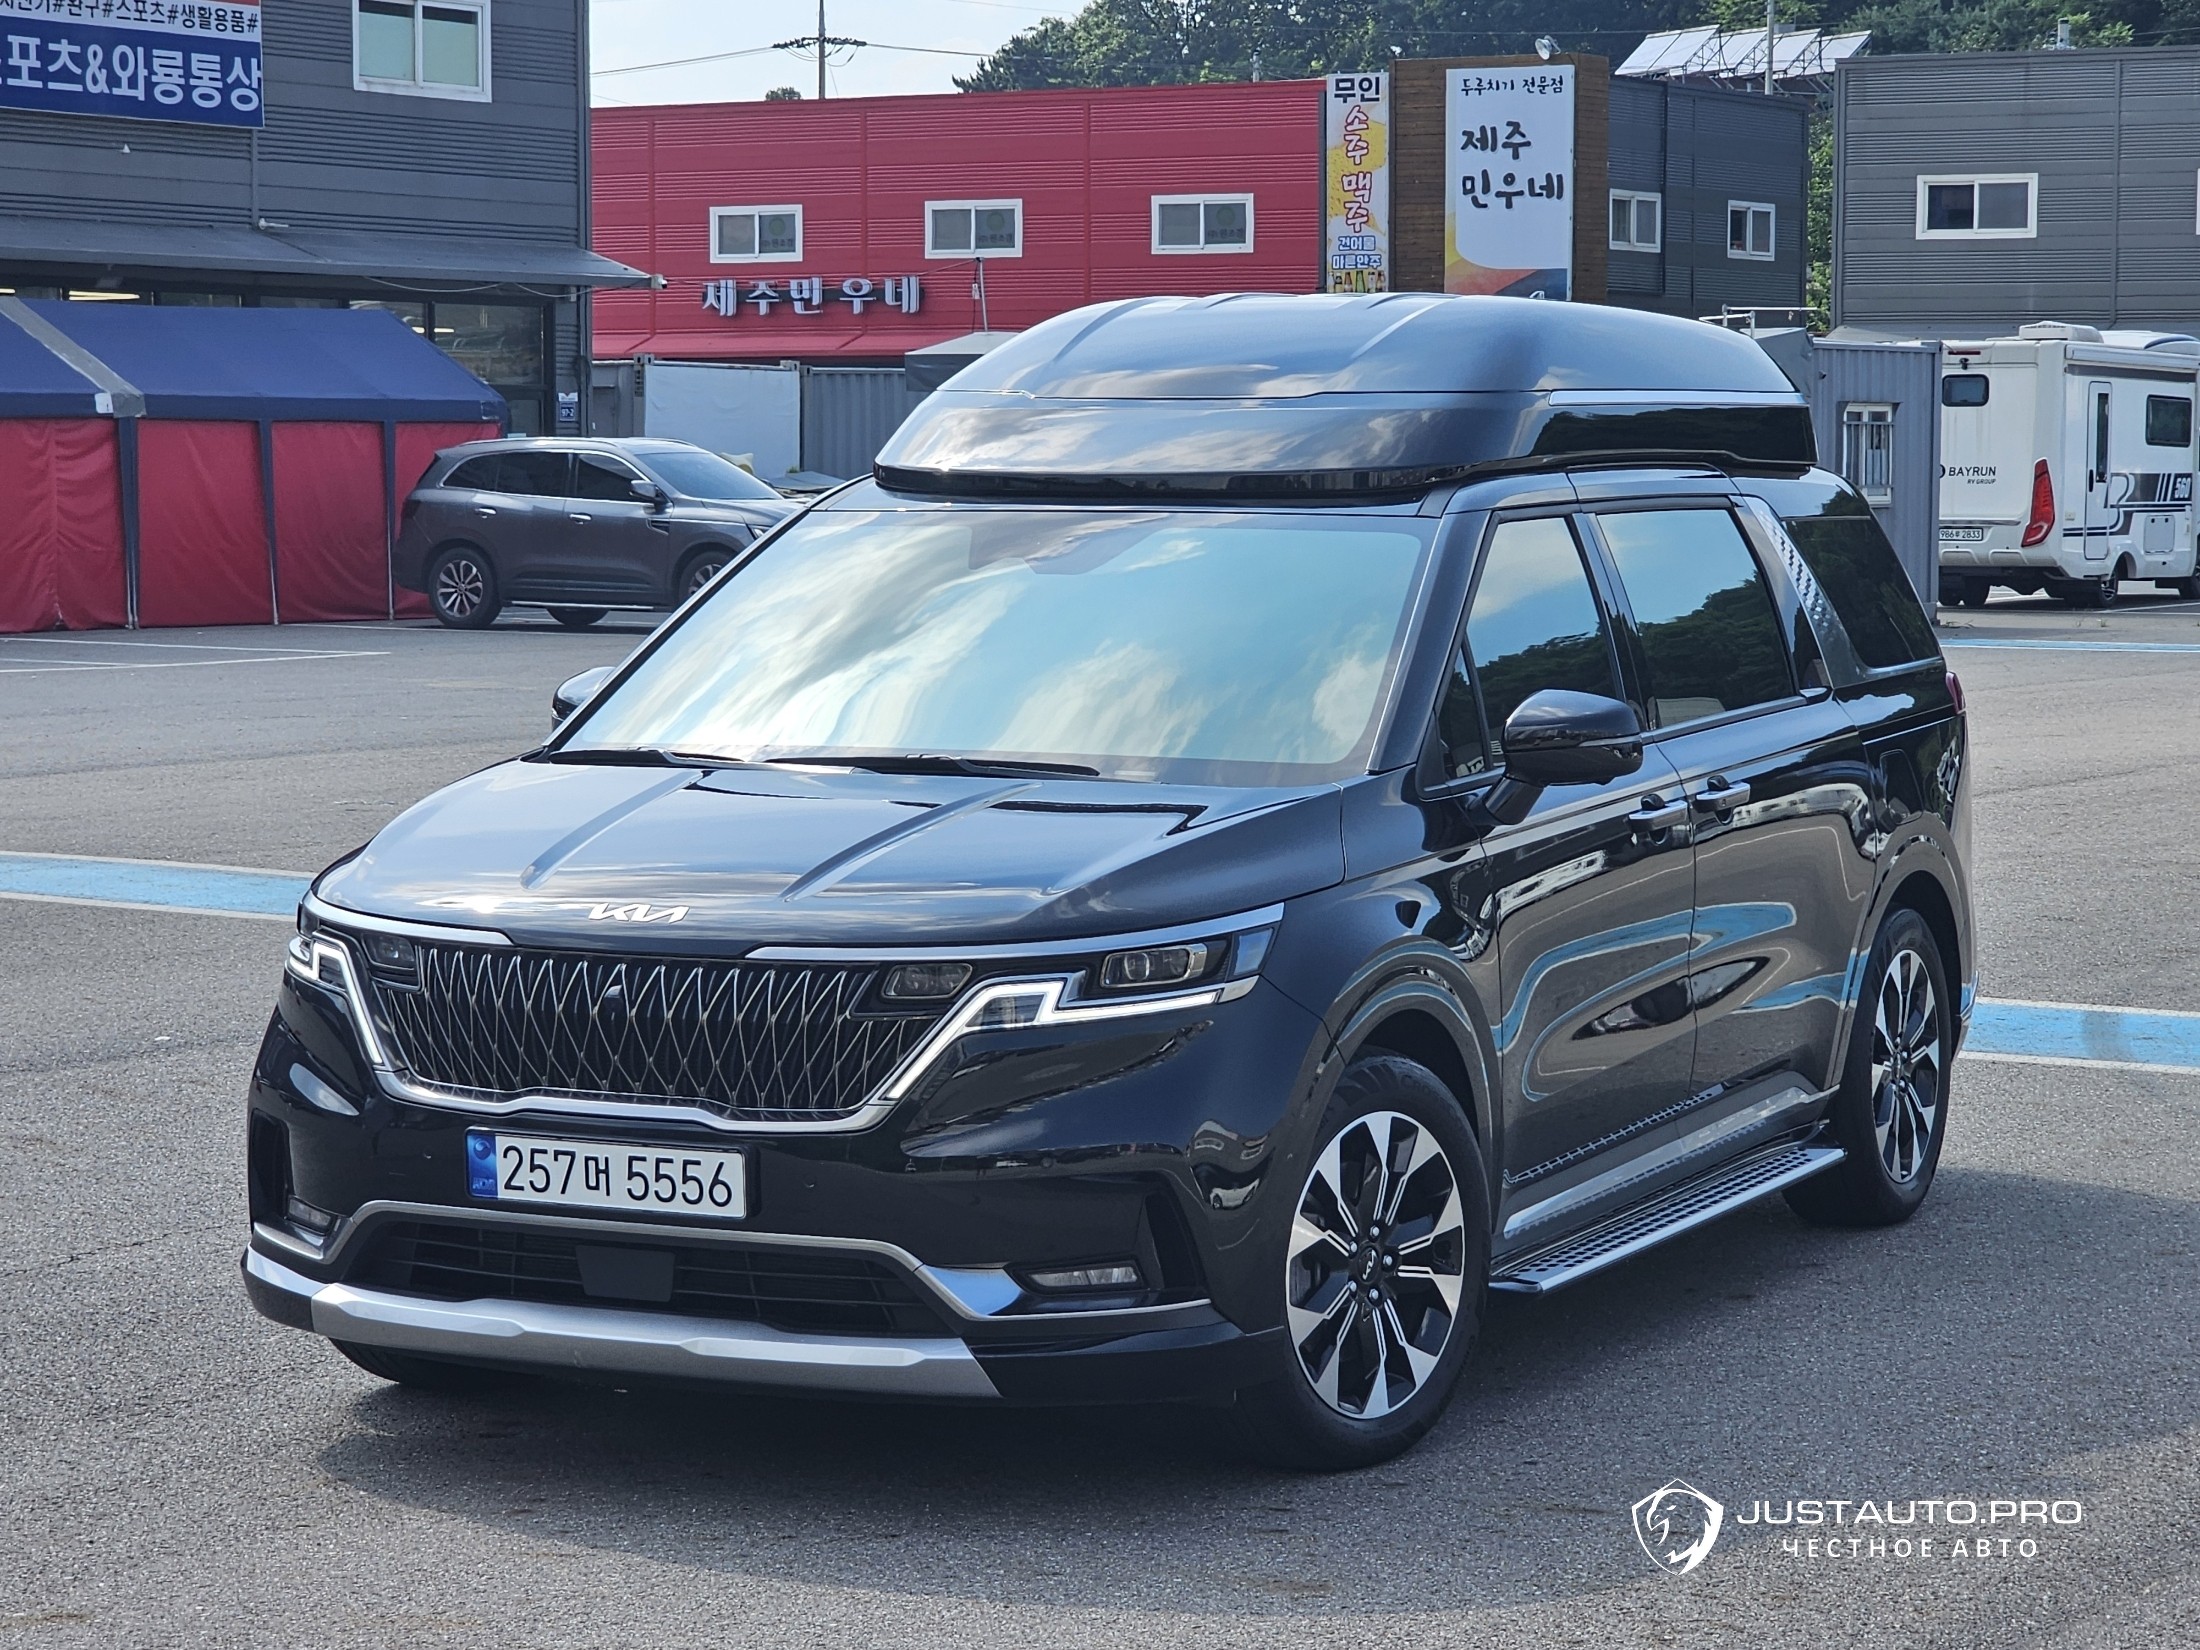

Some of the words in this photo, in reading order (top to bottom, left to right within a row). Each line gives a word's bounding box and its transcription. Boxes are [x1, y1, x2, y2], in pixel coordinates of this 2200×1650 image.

[0, 34, 262, 111] 포츠&와룡통상
[1333, 76, 1381, 103] 무인
[1461, 78, 1515, 97] 두루치기
[1522, 75, 1564, 95] 전문점
[1344, 105, 1369, 165] 소주
[1460, 120, 1532, 160] 제주
[1341, 171, 1372, 233] 맥주
[1461, 169, 1564, 209] 민우네
[1948, 466, 1997, 477] BAYRUN
[588, 902, 690, 924] KIA
[502, 1145, 612, 1197] 257머
[626, 1155, 733, 1207] 5556
